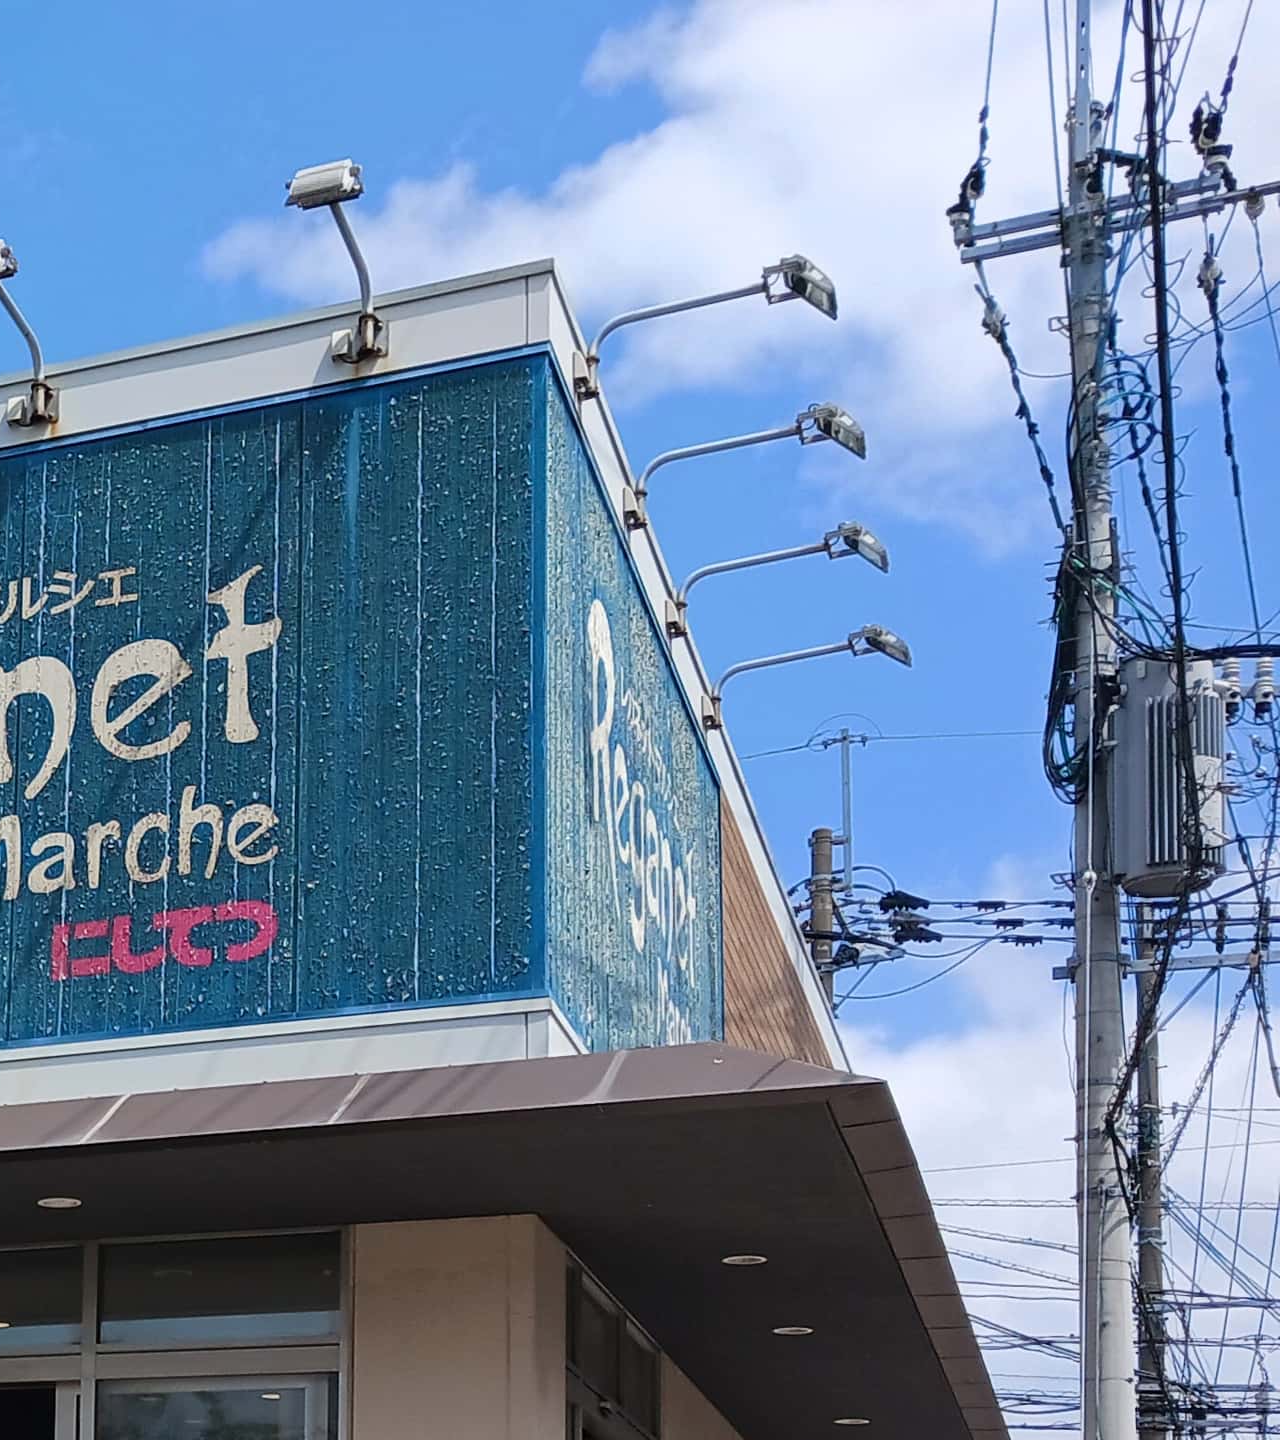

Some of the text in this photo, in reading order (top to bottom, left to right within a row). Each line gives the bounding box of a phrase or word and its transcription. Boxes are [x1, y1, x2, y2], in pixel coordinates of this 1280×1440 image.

[587, 599, 696, 988] Reganet
[51, 899, 278, 982] にしてつ
